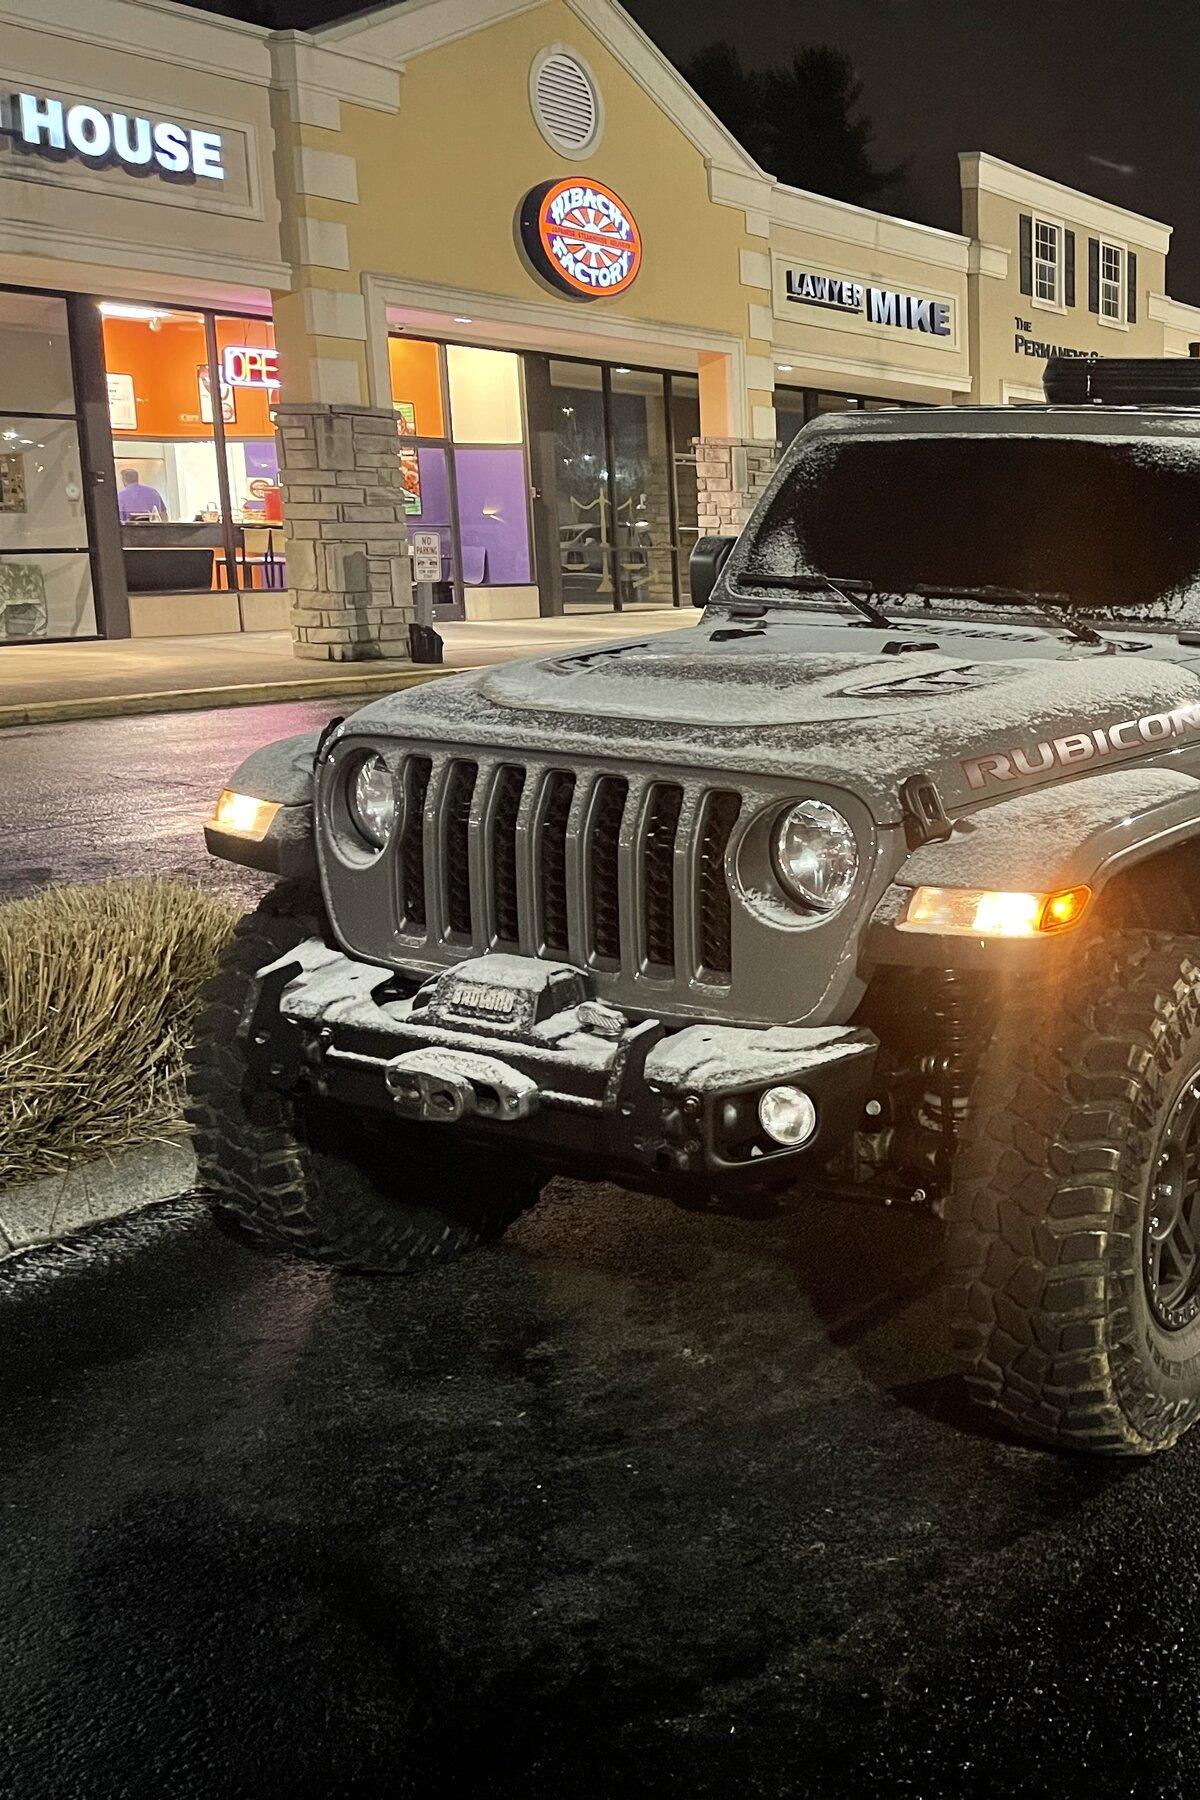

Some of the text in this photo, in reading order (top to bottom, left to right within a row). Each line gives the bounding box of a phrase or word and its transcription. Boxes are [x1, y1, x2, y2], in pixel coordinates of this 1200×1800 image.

[18, 92, 224, 180] HOUSE
[550, 187, 630, 240] HIBACHI
[552, 235, 631, 288] FACTORY
[787, 270, 950, 336] LAWYER MIKE
[1015, 316, 1032, 332] THE
[231, 350, 279, 383] OPE
[417, 546, 437, 554] PARKING
[422, 536, 431, 545] NO
